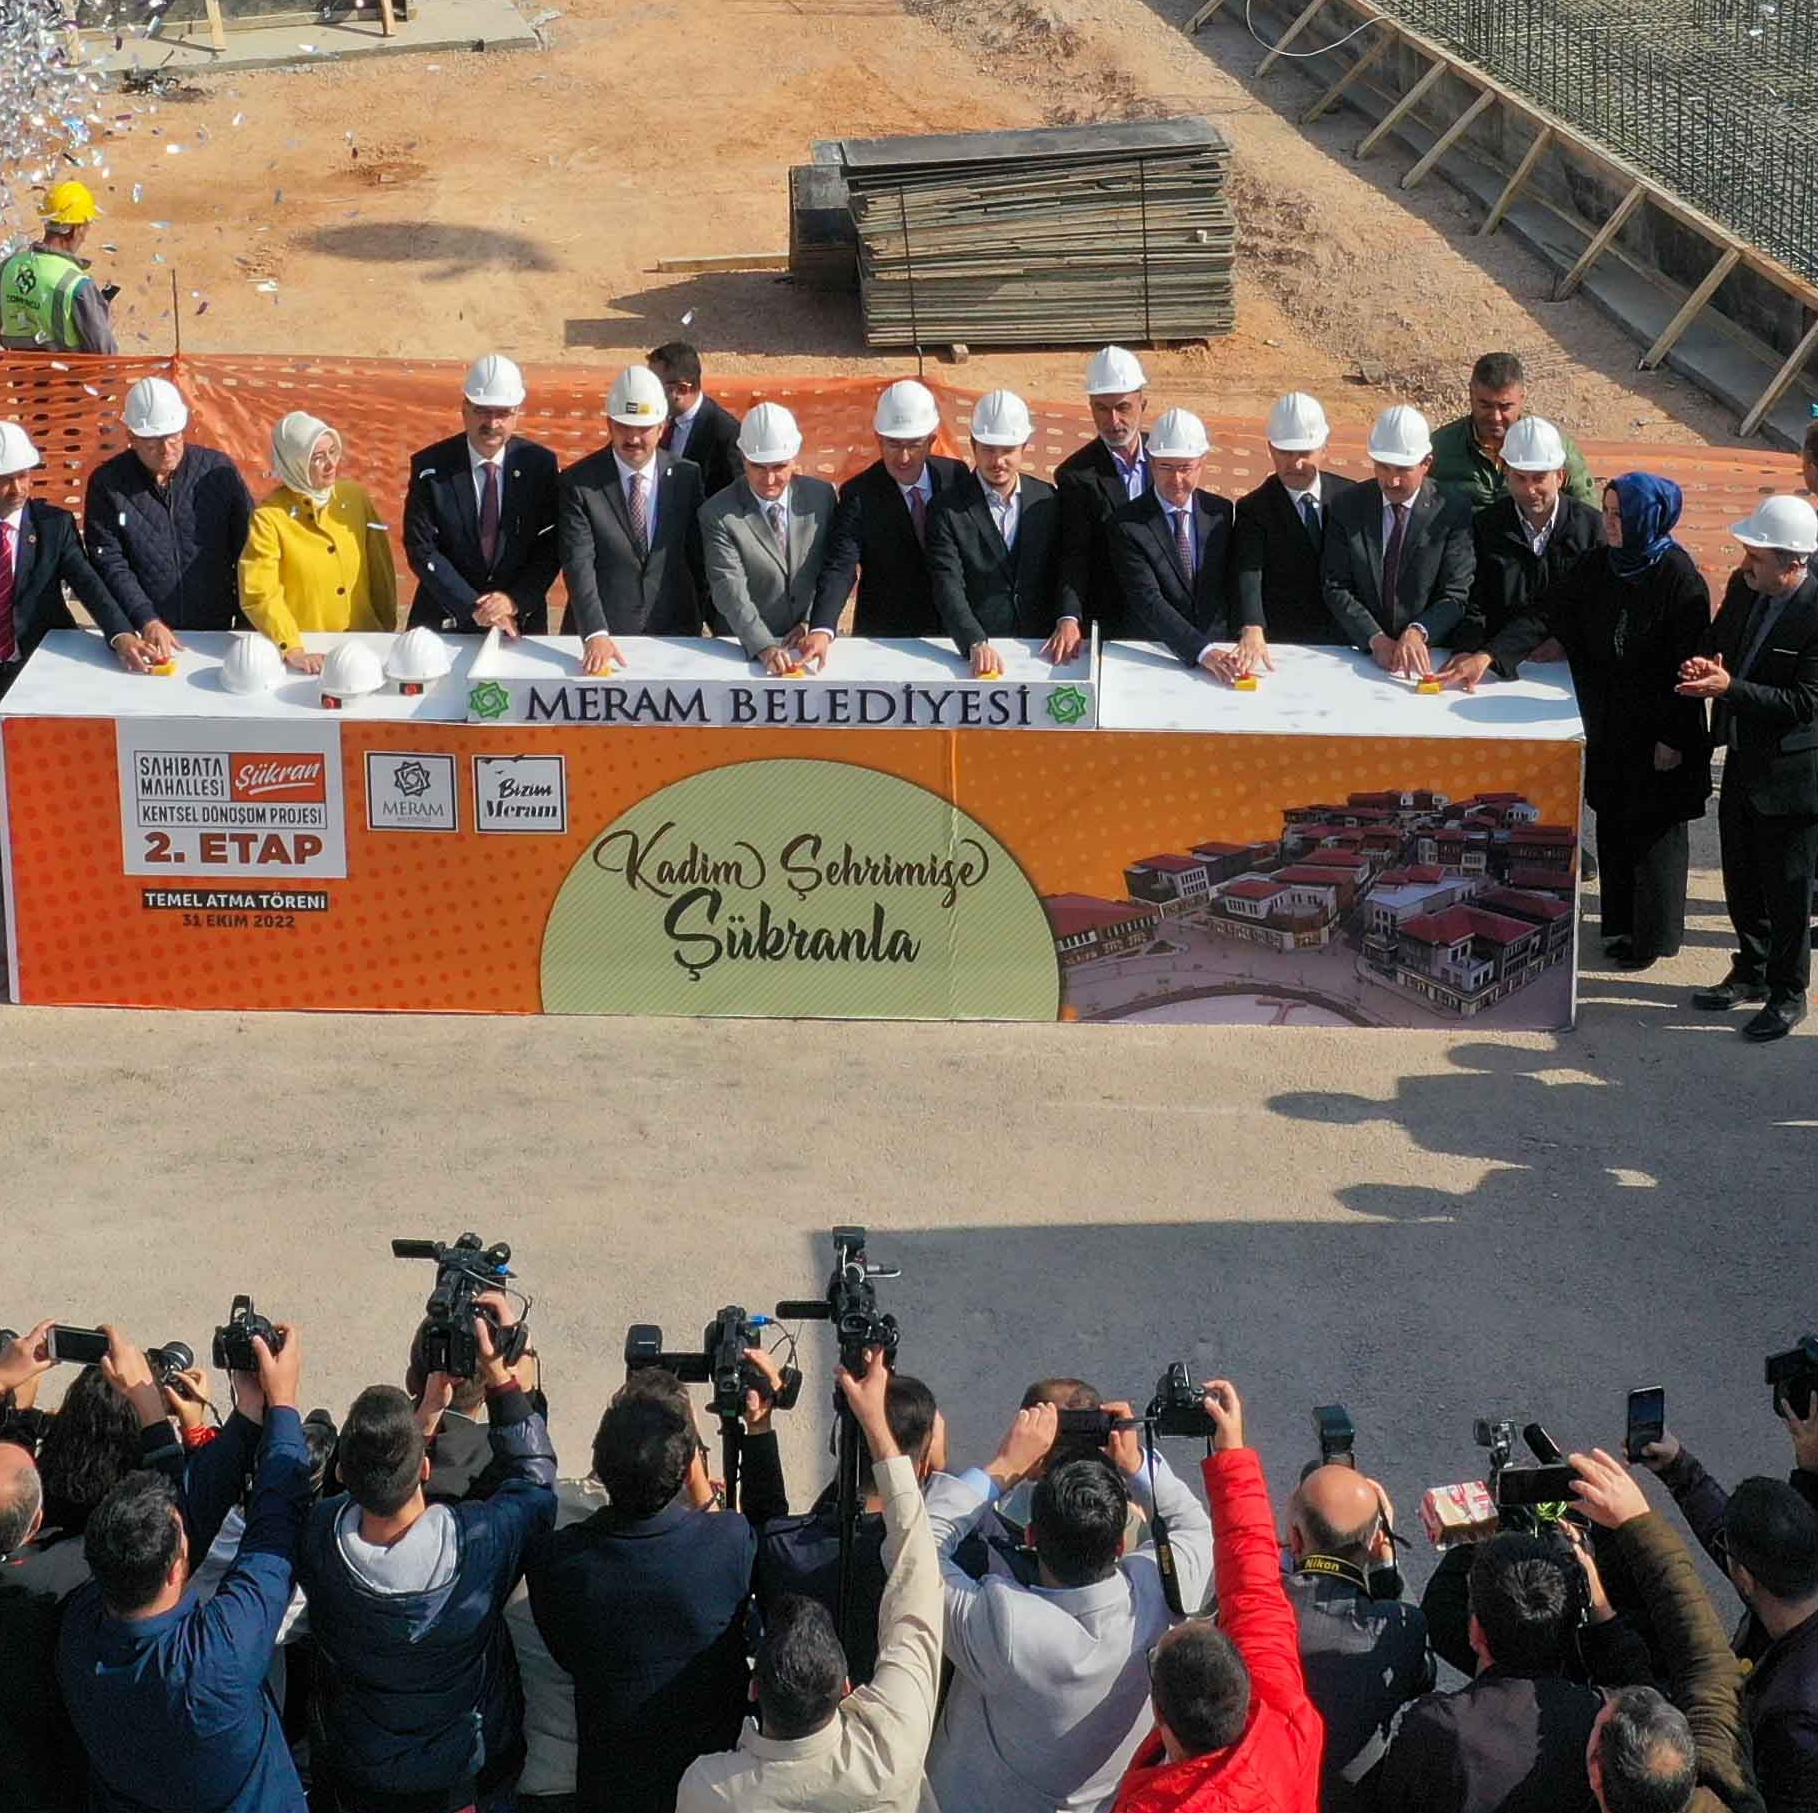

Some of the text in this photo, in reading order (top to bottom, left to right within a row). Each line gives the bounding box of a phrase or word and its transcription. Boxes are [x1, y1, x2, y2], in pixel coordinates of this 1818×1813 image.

[527, 683, 1032, 726] MERAM BELEDİYESİ
[235, 762, 320, 790] Şükran
[142, 805, 199, 823] KENTSEL
[382, 800, 444, 817] MERAM
[485, 800, 558, 818] Meram
[144, 831, 323, 865] 2. ETAP
[592, 820, 990, 908] Kadim Şehrimize
[145, 891, 325, 910] TEMEL ATMA TÖRENİ
[183, 914, 202, 928] 31
[253, 914, 296, 929] 2022
[663, 887, 922, 982] Şükranla
[1304, 1558, 1340, 1574] Nikon
